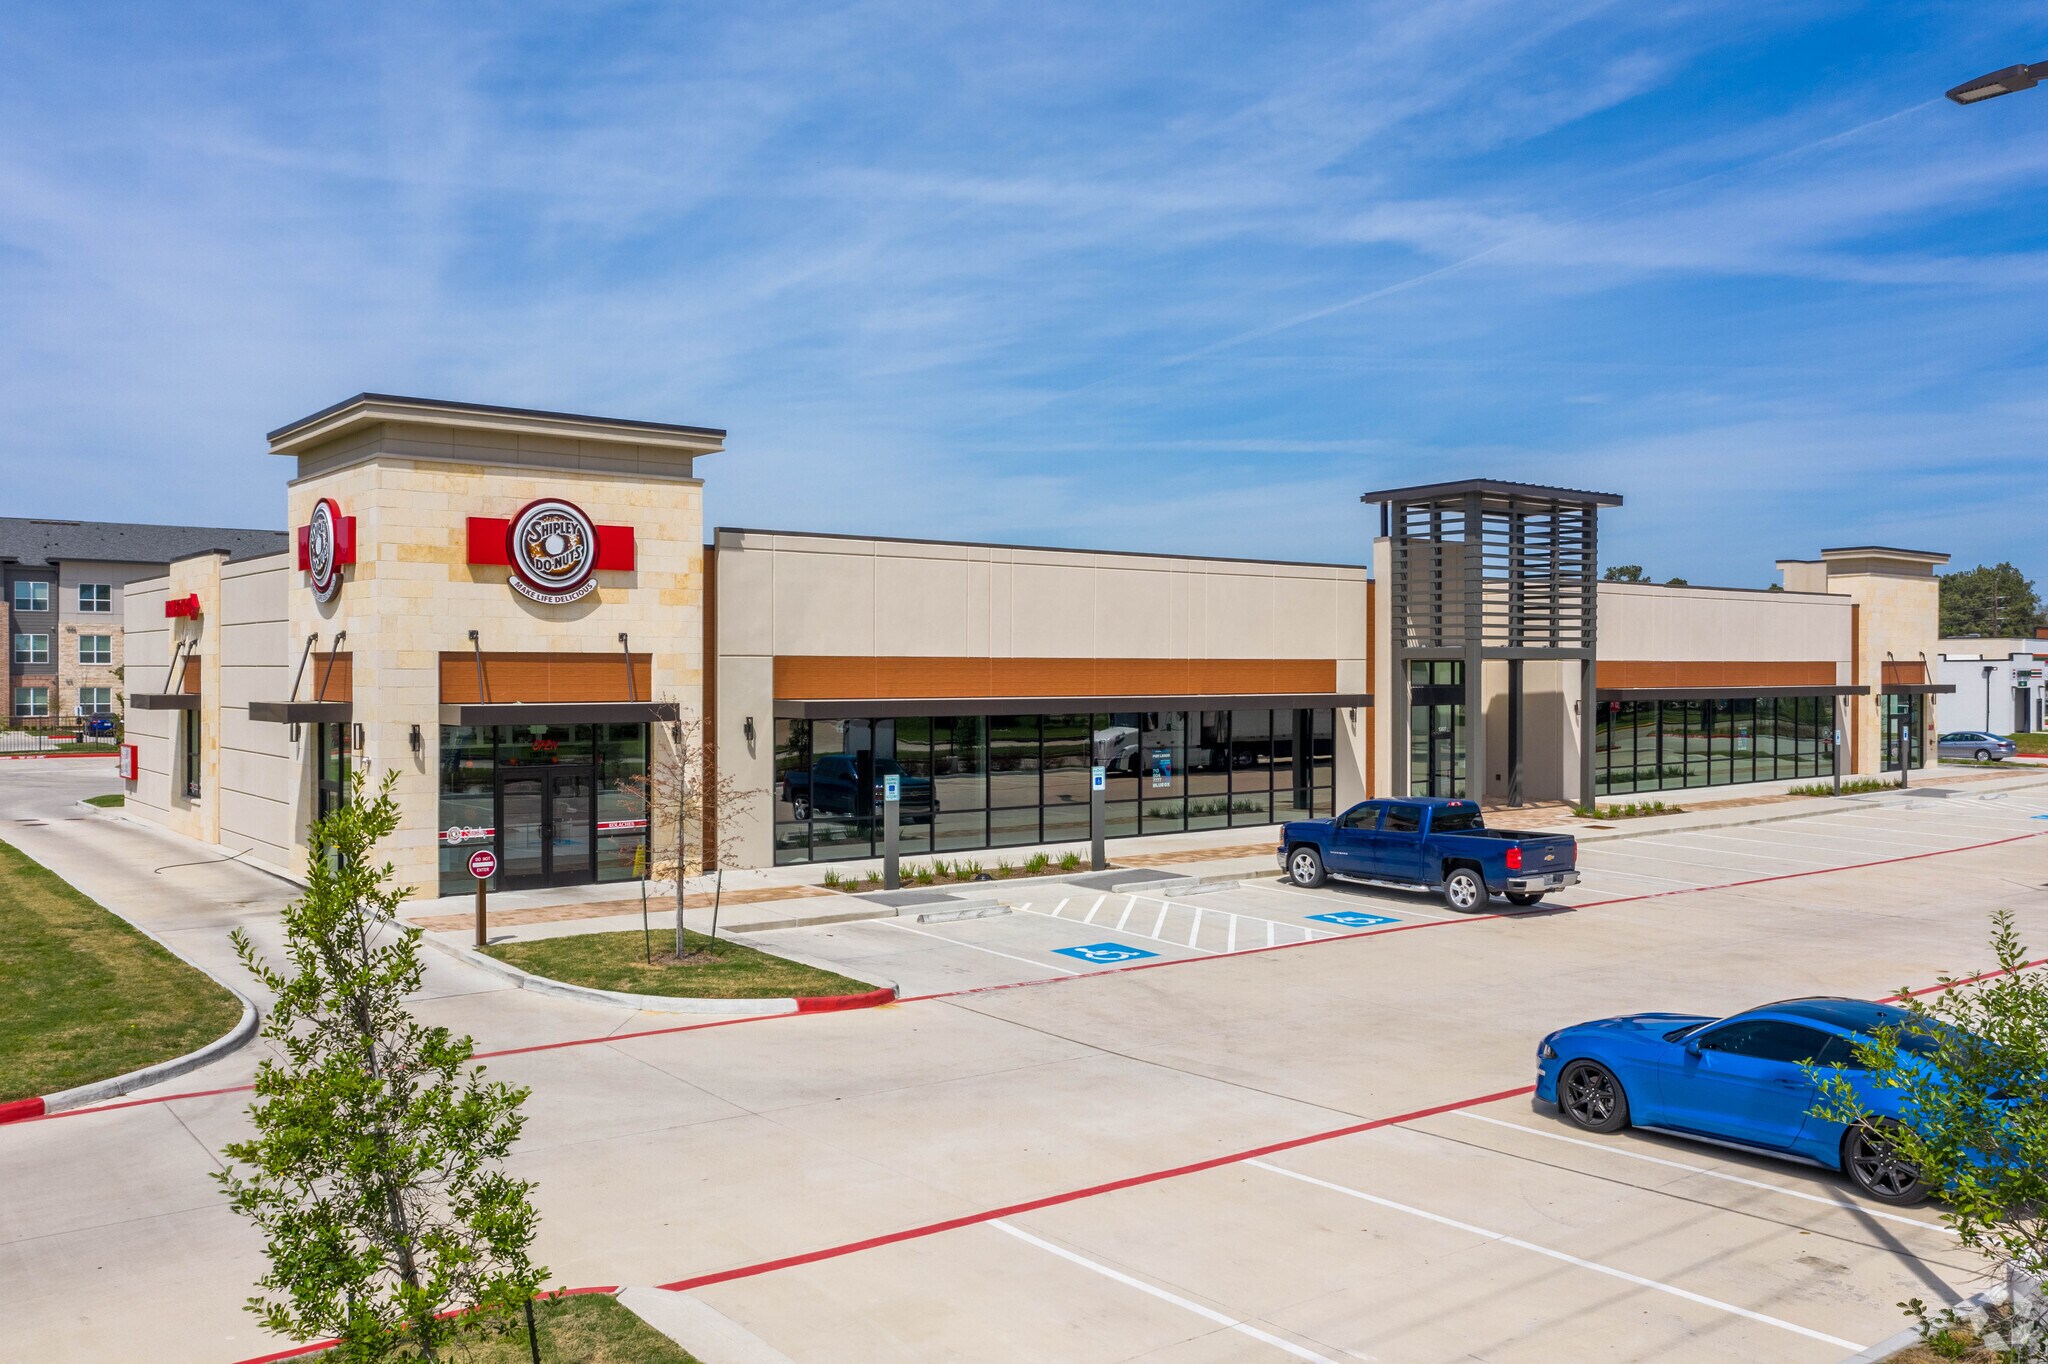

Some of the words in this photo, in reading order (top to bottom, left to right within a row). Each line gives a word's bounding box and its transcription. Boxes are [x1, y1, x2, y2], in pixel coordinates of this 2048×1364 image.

[527, 520, 579, 543] SHIPLEY
[535, 546, 583, 571] DO-NUTS
[514, 581, 535, 598] MAKE
[536, 594, 553, 603] LIFE
[554, 583, 593, 603] DELICIOUS
[532, 739, 558, 751] OPEN
